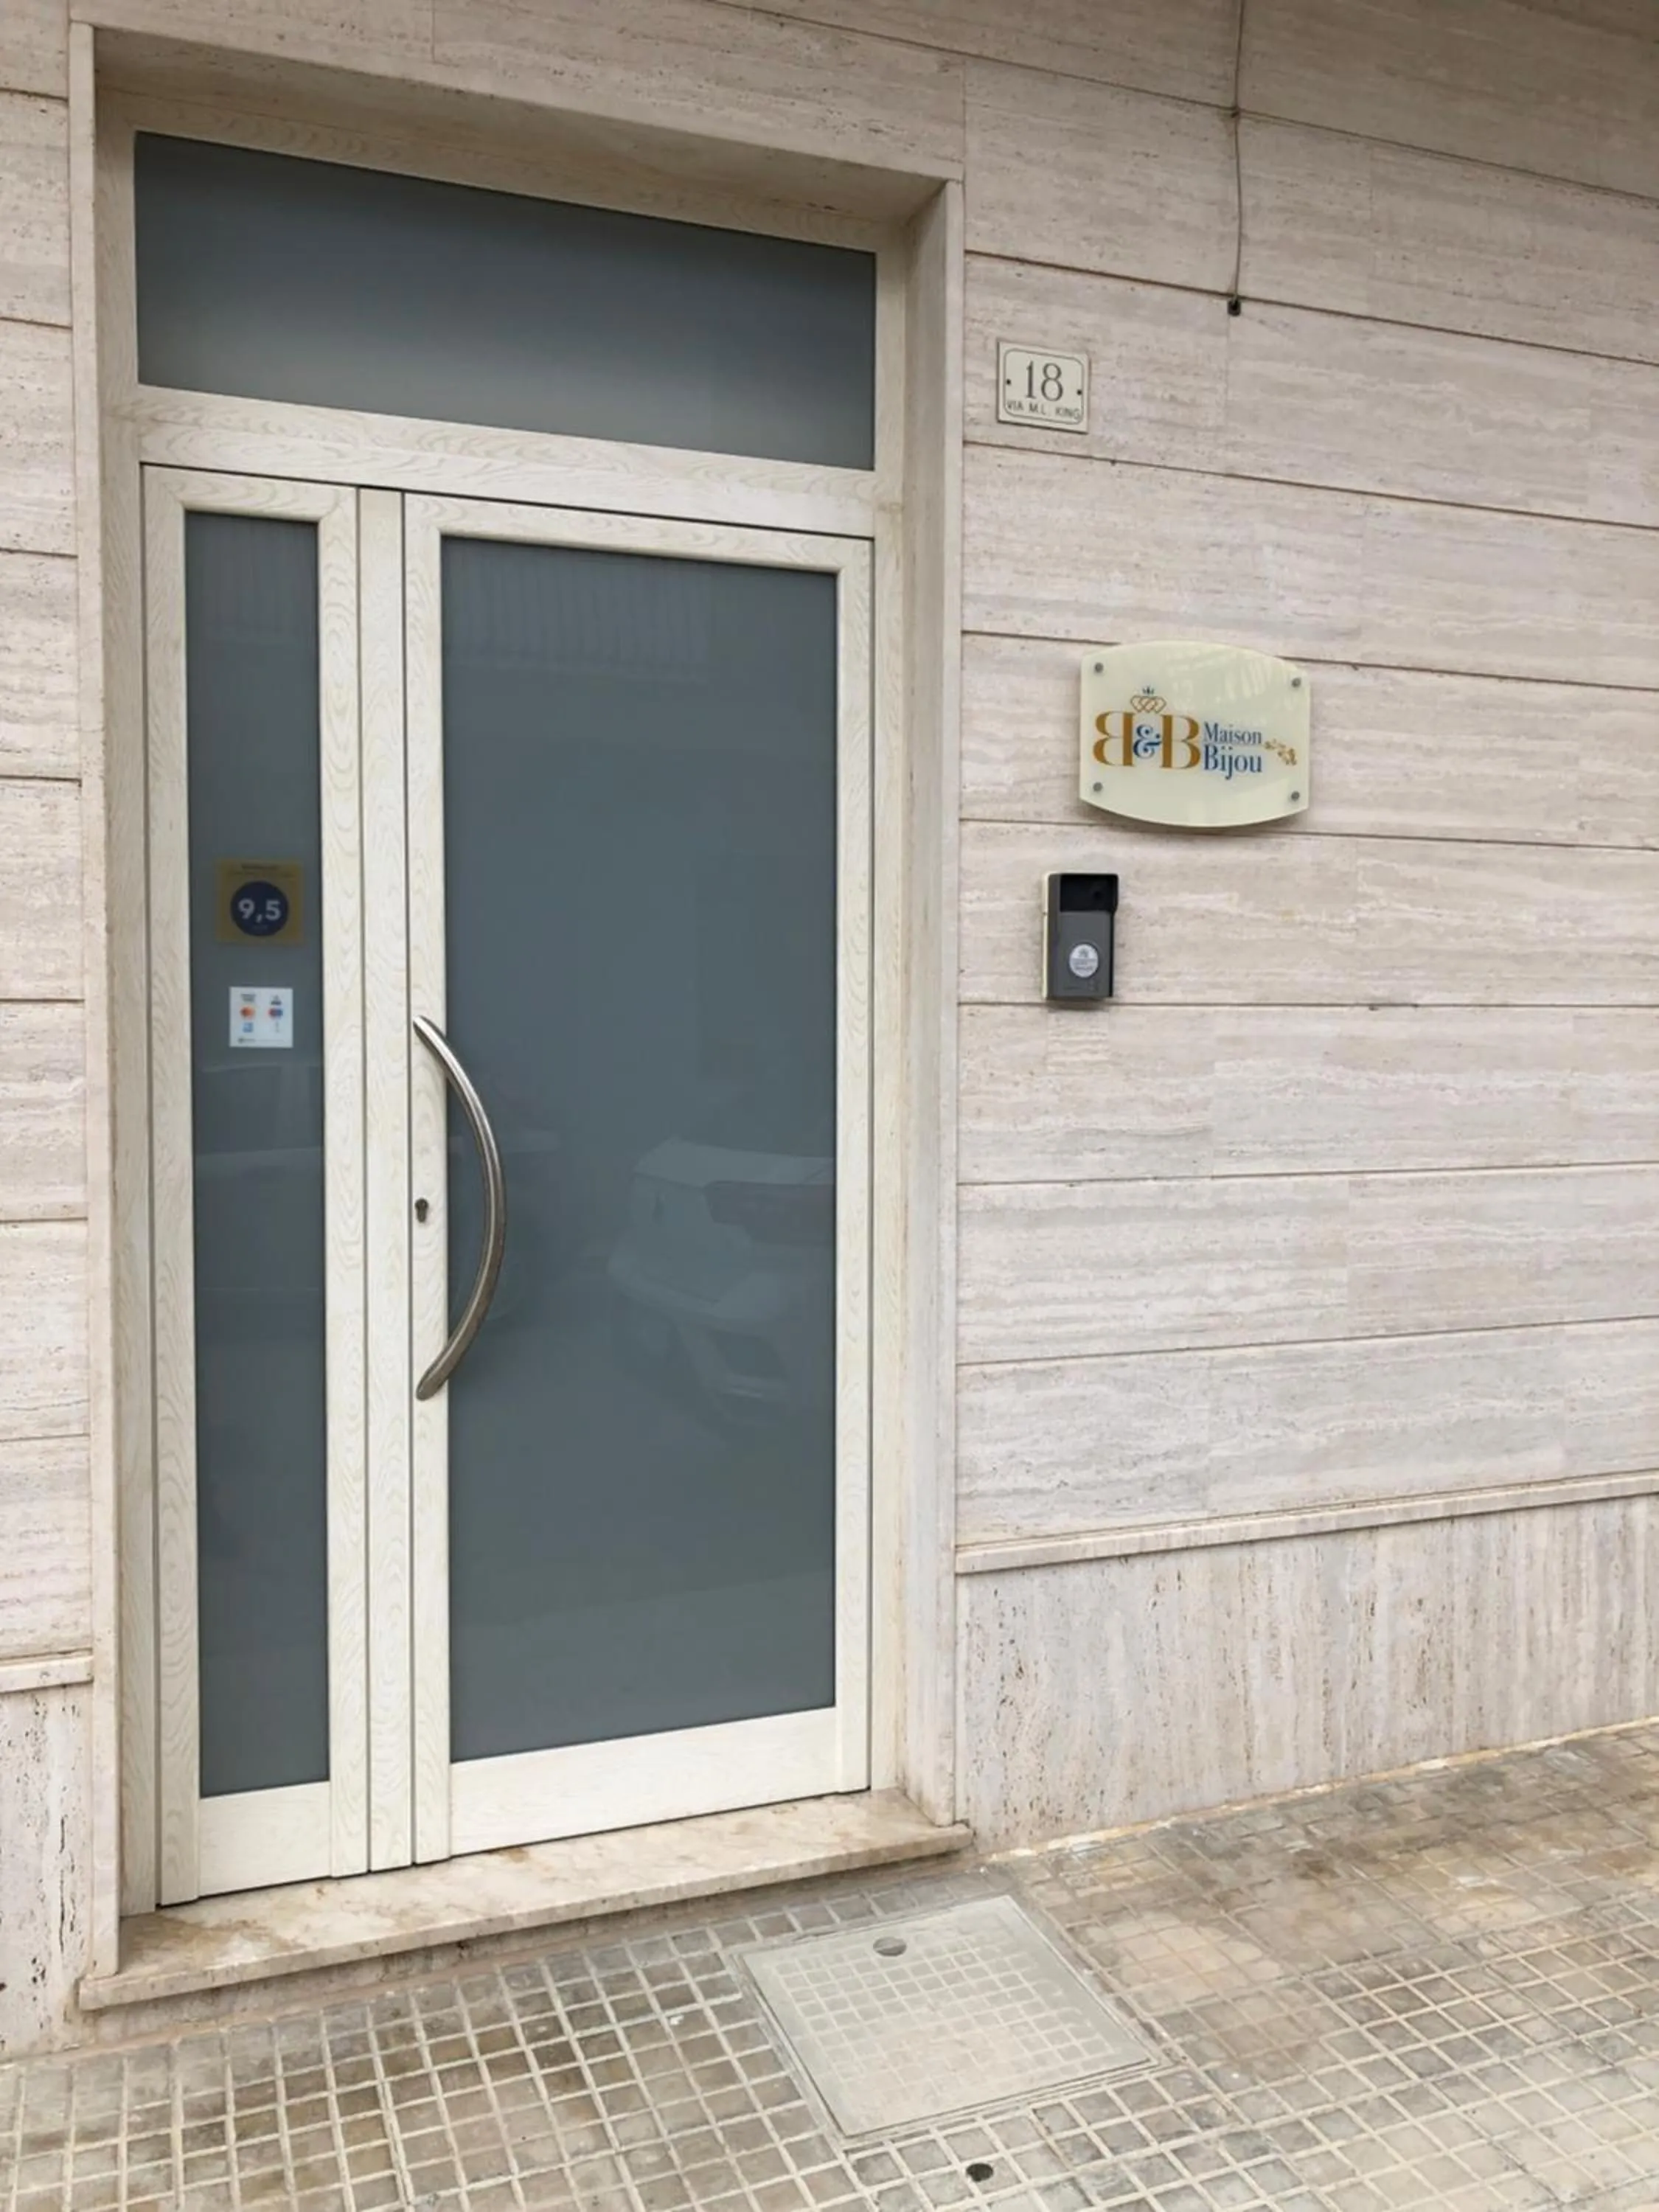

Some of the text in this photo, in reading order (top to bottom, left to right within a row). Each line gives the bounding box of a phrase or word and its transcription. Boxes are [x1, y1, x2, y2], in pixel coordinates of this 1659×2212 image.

[1025, 360, 1063, 402] 18
[1006, 400, 1023, 411] VIA
[1093, 710, 1201, 770] B&B
[1203, 721, 1262, 745] Maison
[1203, 743, 1263, 780] Bijou
[237, 898, 282, 923] 9,5
